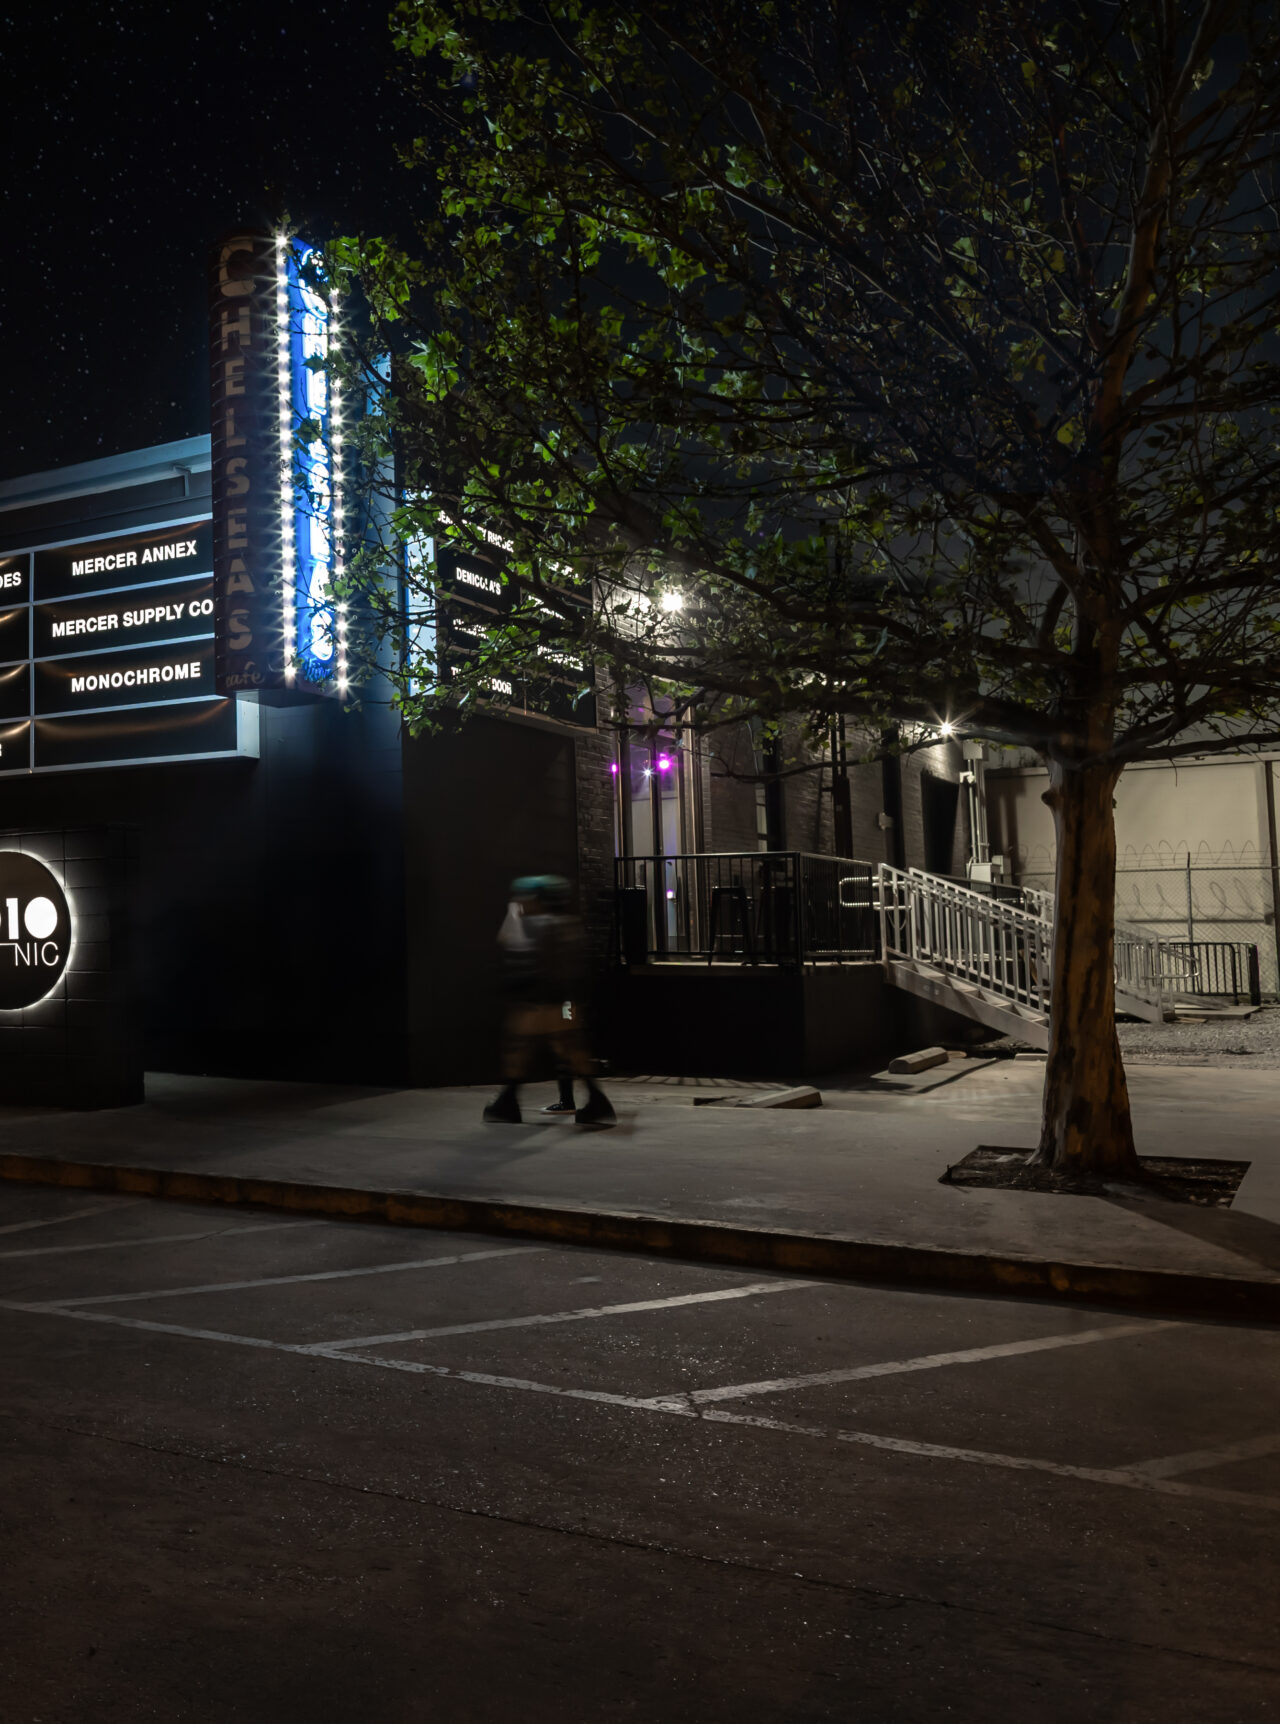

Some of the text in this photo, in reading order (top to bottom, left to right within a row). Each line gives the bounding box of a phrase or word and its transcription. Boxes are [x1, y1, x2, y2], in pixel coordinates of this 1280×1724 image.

[218, 235, 257, 651] CHELSEAS
[72, 539, 197, 576] MERCER ANNEX
[52, 598, 214, 638] MERCER SUPPLY CO
[71, 661, 201, 693] MONOCHROME
[14, 941, 60, 967] NIC
